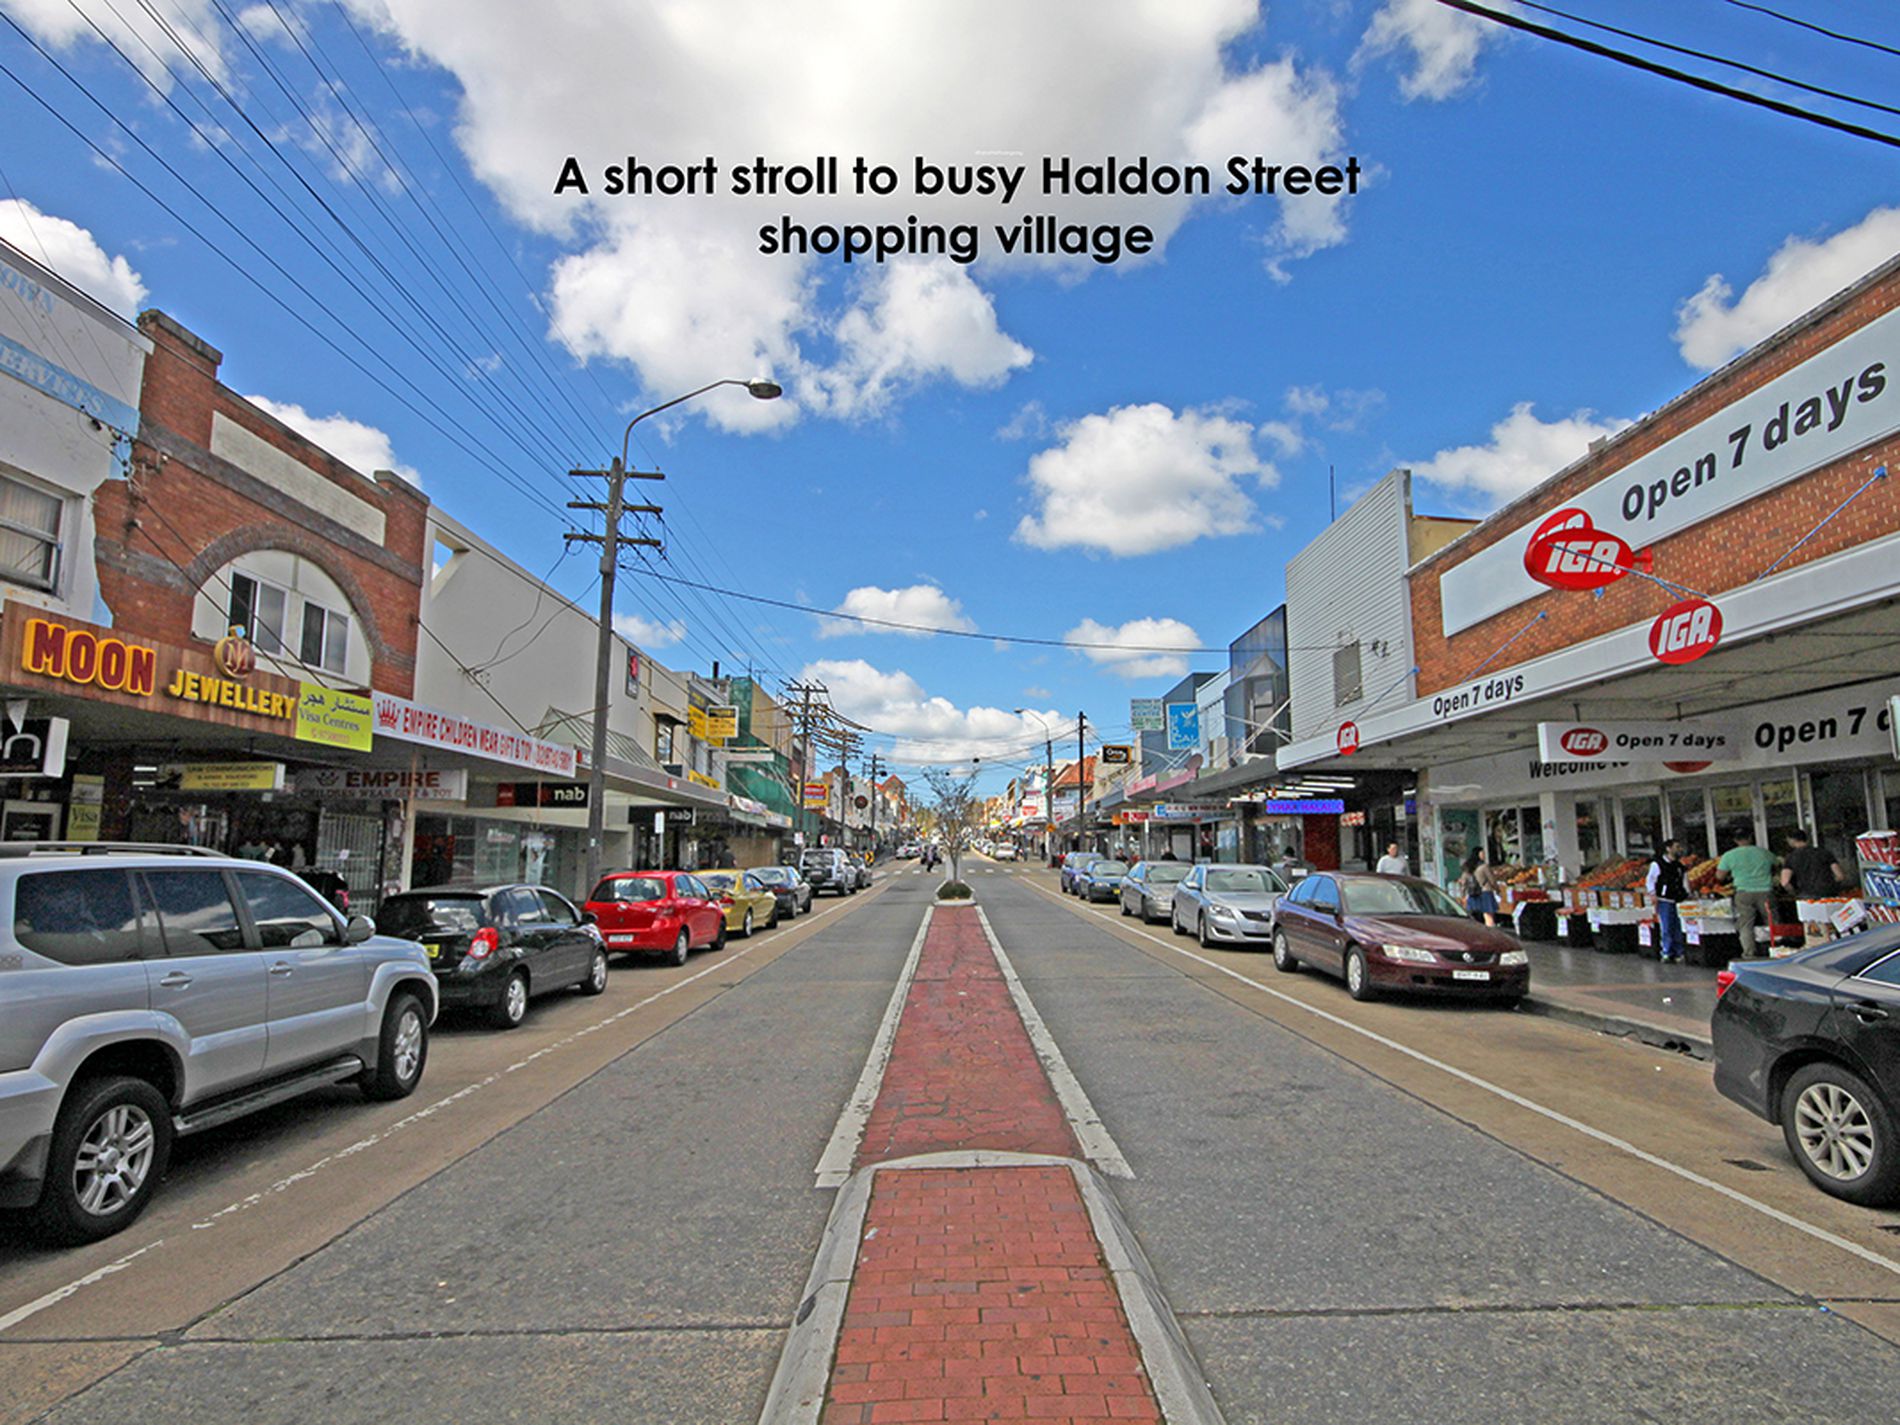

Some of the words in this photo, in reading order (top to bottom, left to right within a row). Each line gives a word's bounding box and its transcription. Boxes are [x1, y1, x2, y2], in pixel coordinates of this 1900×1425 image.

[0, 264, 54, 314] OWN
[1622, 452, 1717, 521] Open
[1728, 424, 1752, 469] 7
[1763, 362, 1887, 451] days
[1545, 541, 1621, 574] IGA
[1656, 605, 1713, 656] IGA
[24, 618, 156, 697] MOON
[169, 669, 296, 719] JEWELLERY
[299, 707, 320, 723] Visa
[1433, 697, 1470, 718] Open
[1473, 685, 1482, 705] 7
[1485, 674, 1525, 700] days
[403, 707, 439, 739] EMPIRE
[440, 716, 479, 750] CHILDREN
[480, 727, 498, 753] WEAR
[1566, 733, 1603, 750] IGA
[1616, 733, 1664, 749] Open
[1668, 734, 1679, 747] 7
[1683, 733, 1726, 749] days
[1755, 717, 1838, 752] Open
[1847, 707, 1867, 735] 7
[346, 771, 441, 788] EMPIRE
[554, 786, 585, 801] nab
[669, 810, 692, 821] nab
